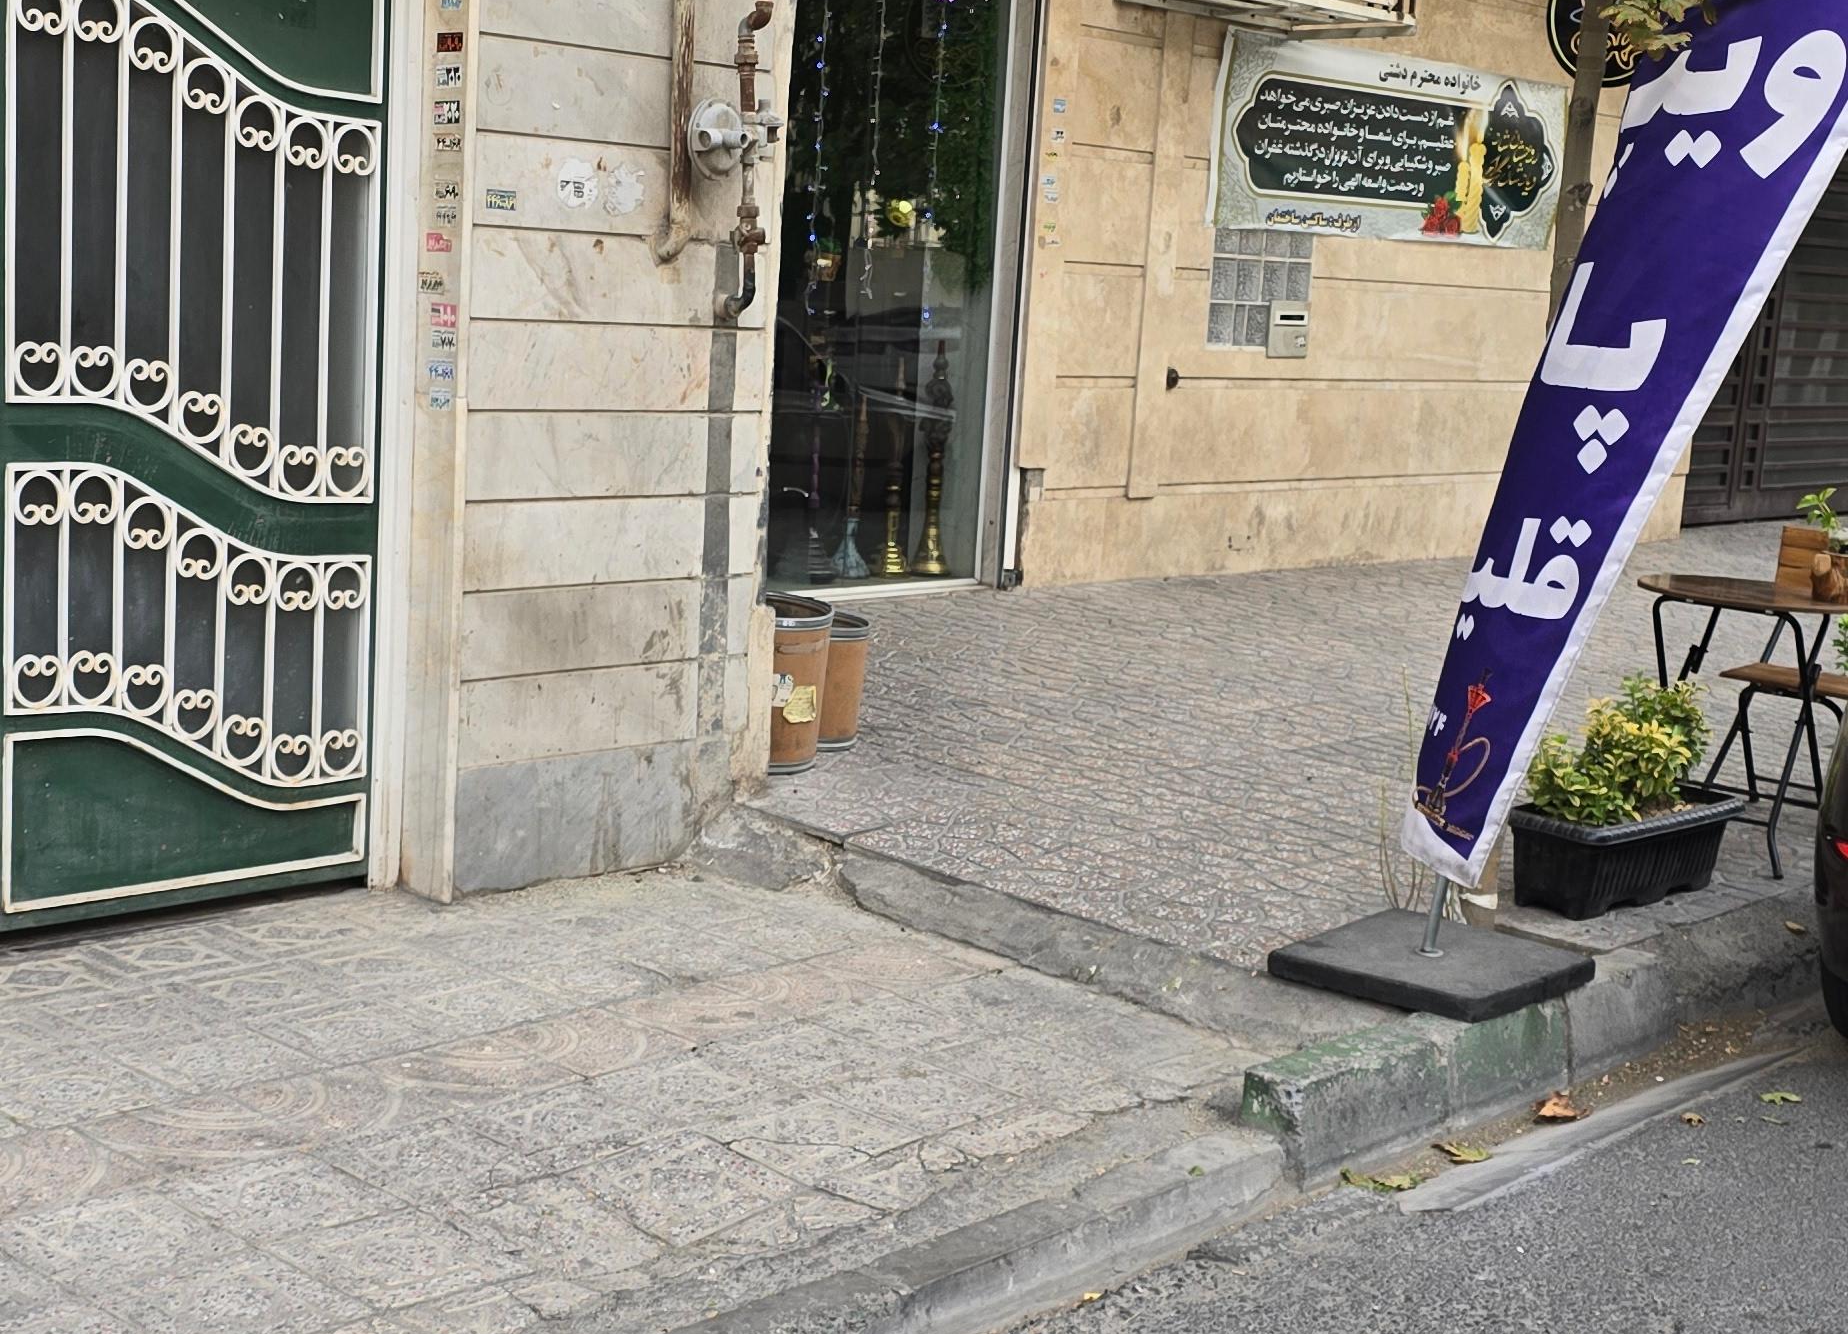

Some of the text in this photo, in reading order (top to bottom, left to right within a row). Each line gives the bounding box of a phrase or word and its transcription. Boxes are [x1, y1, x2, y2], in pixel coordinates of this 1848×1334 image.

[1410, 69, 1442, 88] محترم
[1444, 73, 1482, 95] خانواده
[1310, 97, 1341, 115] صبری
[1341, 98, 1376, 119] عزیزان
[1376, 104, 1399, 119] دادن
[1399, 109, 1429, 122] دست
[1428, 110, 1438, 127] از
[1437, 112, 1455, 129] غم
[1316, 120, 1359, 142] خانواده
[1357, 128, 1365, 143] و
[1364, 125, 1393, 141] شما
[1392, 130, 1417, 149] برای
[1254, 138, 1283, 159] غفران
[1347, 146, 1364, 164] آن
[1362, 150, 1384, 170] برای
[1390, 154, 1427, 172] شکیبایی
[1425, 160, 1433, 175] و
[1432, 162, 1452, 176] صبر
[1332, 170, 1340, 187] را
[1338, 172, 1363, 191] الهی
[1456, 515, 1592, 641] قلی
